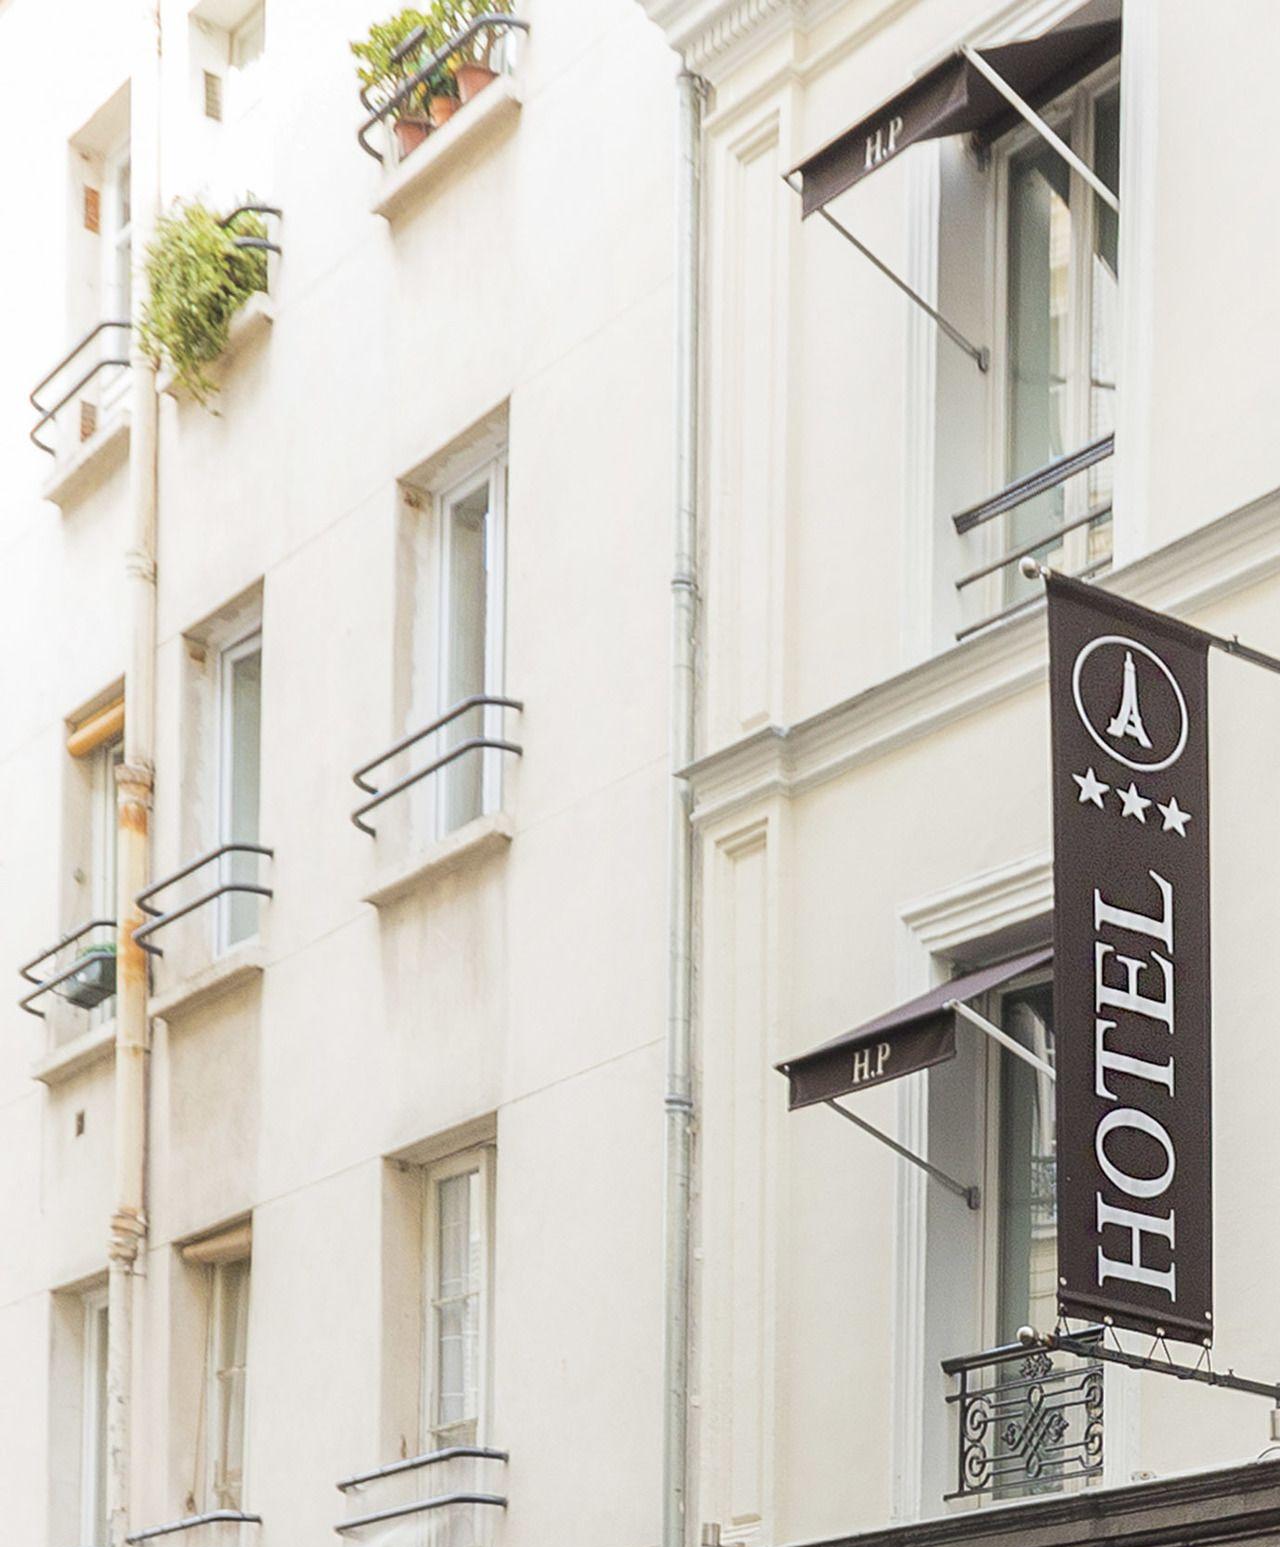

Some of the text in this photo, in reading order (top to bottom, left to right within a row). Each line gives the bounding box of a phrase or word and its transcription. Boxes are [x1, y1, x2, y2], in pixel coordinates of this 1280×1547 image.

[863, 116, 903, 171] H.P
[852, 1042, 891, 1084] H.P
[1093, 869, 1177, 1303] HOTEL
